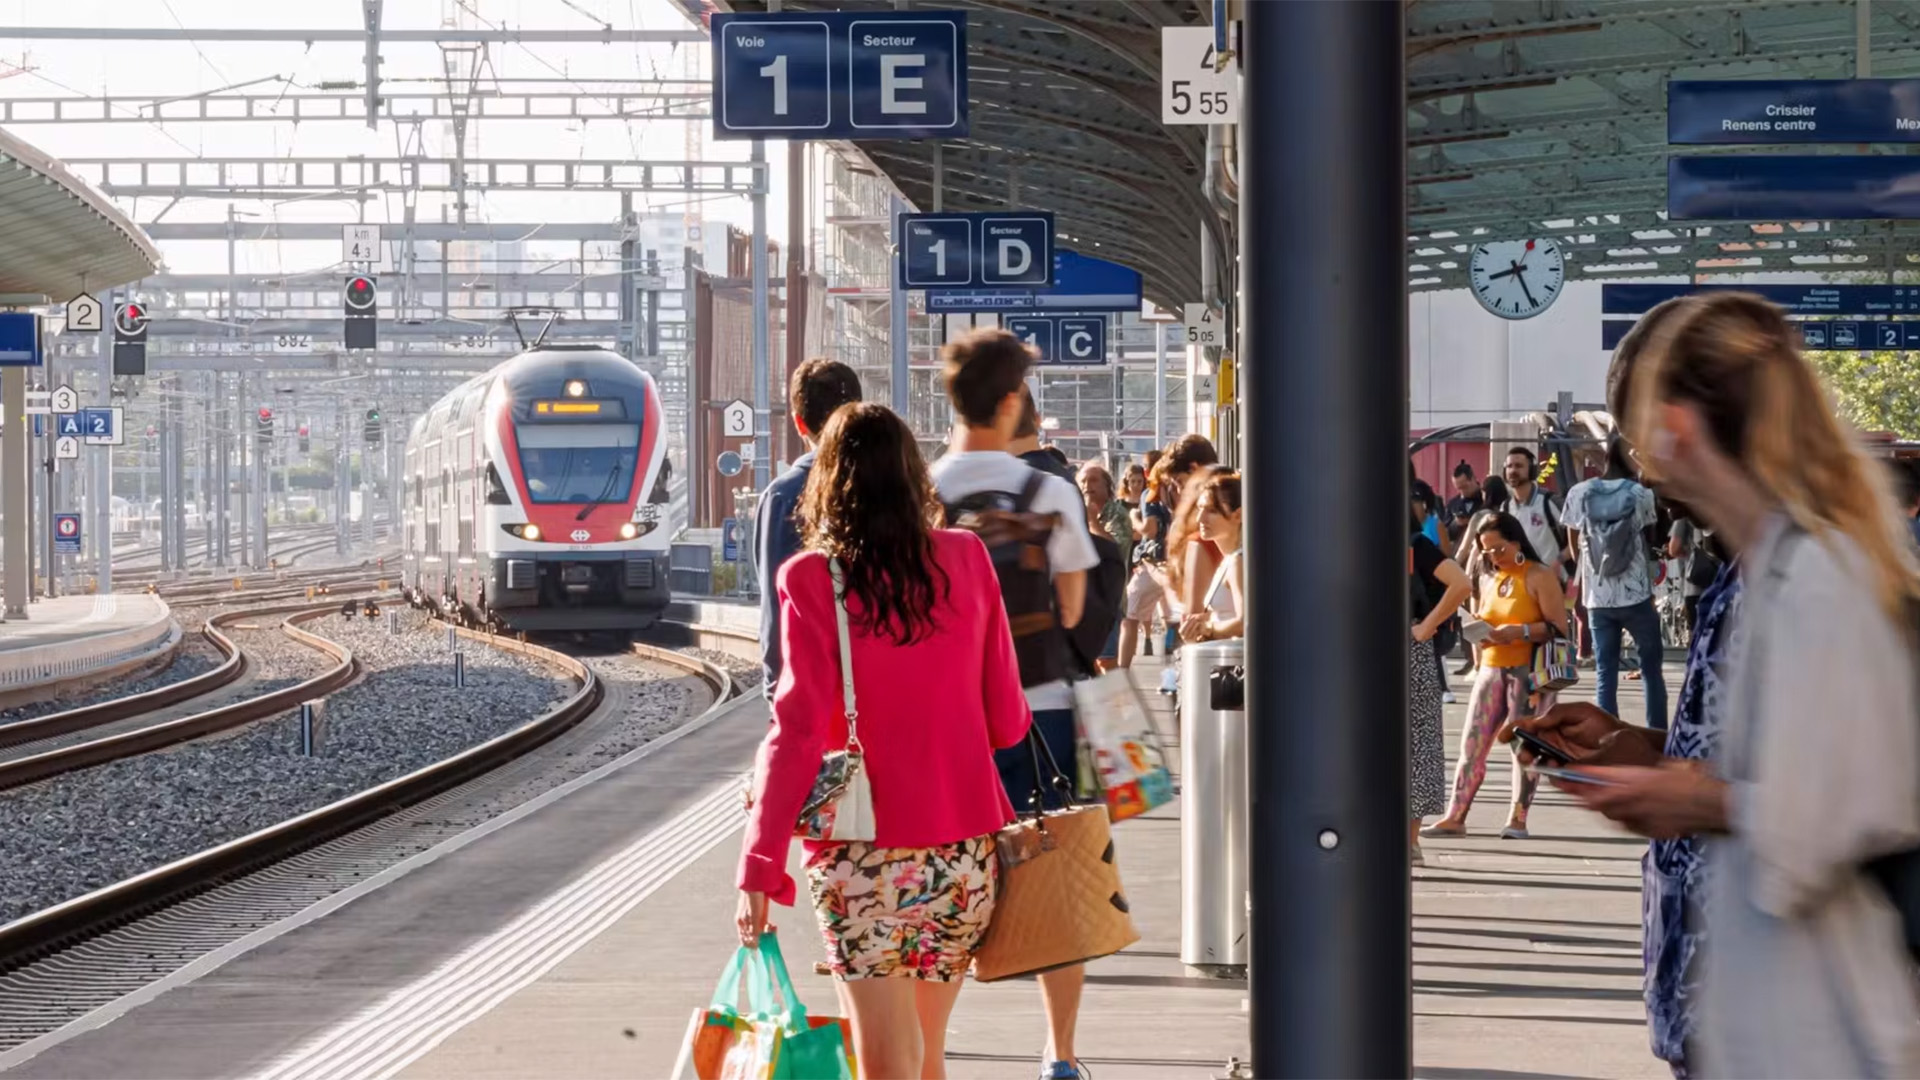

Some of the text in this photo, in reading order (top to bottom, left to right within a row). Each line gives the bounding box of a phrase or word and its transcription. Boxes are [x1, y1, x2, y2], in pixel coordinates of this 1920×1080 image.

[736, 36, 765, 48] Voie
[863, 35, 916, 47] Secteur
[760, 55, 788, 115] 1
[880, 54, 927, 114] E
[1765, 104, 1816, 116] Crissier
[1722, 119, 1816, 131] Renens centre
[354, 227, 370, 240] km
[990, 226, 1022, 235] Secteur
[928, 239, 946, 276] 1
[998, 238, 1032, 276] D
[77, 304, 92, 325] 2
[1201, 308, 1211, 323] 4
[1069, 331, 1093, 357] C
[1885, 330, 1897, 345] 2
[1203, 378, 1211, 388] 4
[58, 392, 71, 409] 3
[64, 418, 105, 433] A 2
[732, 410, 746, 432] 3
[61, 440, 71, 455] 4
